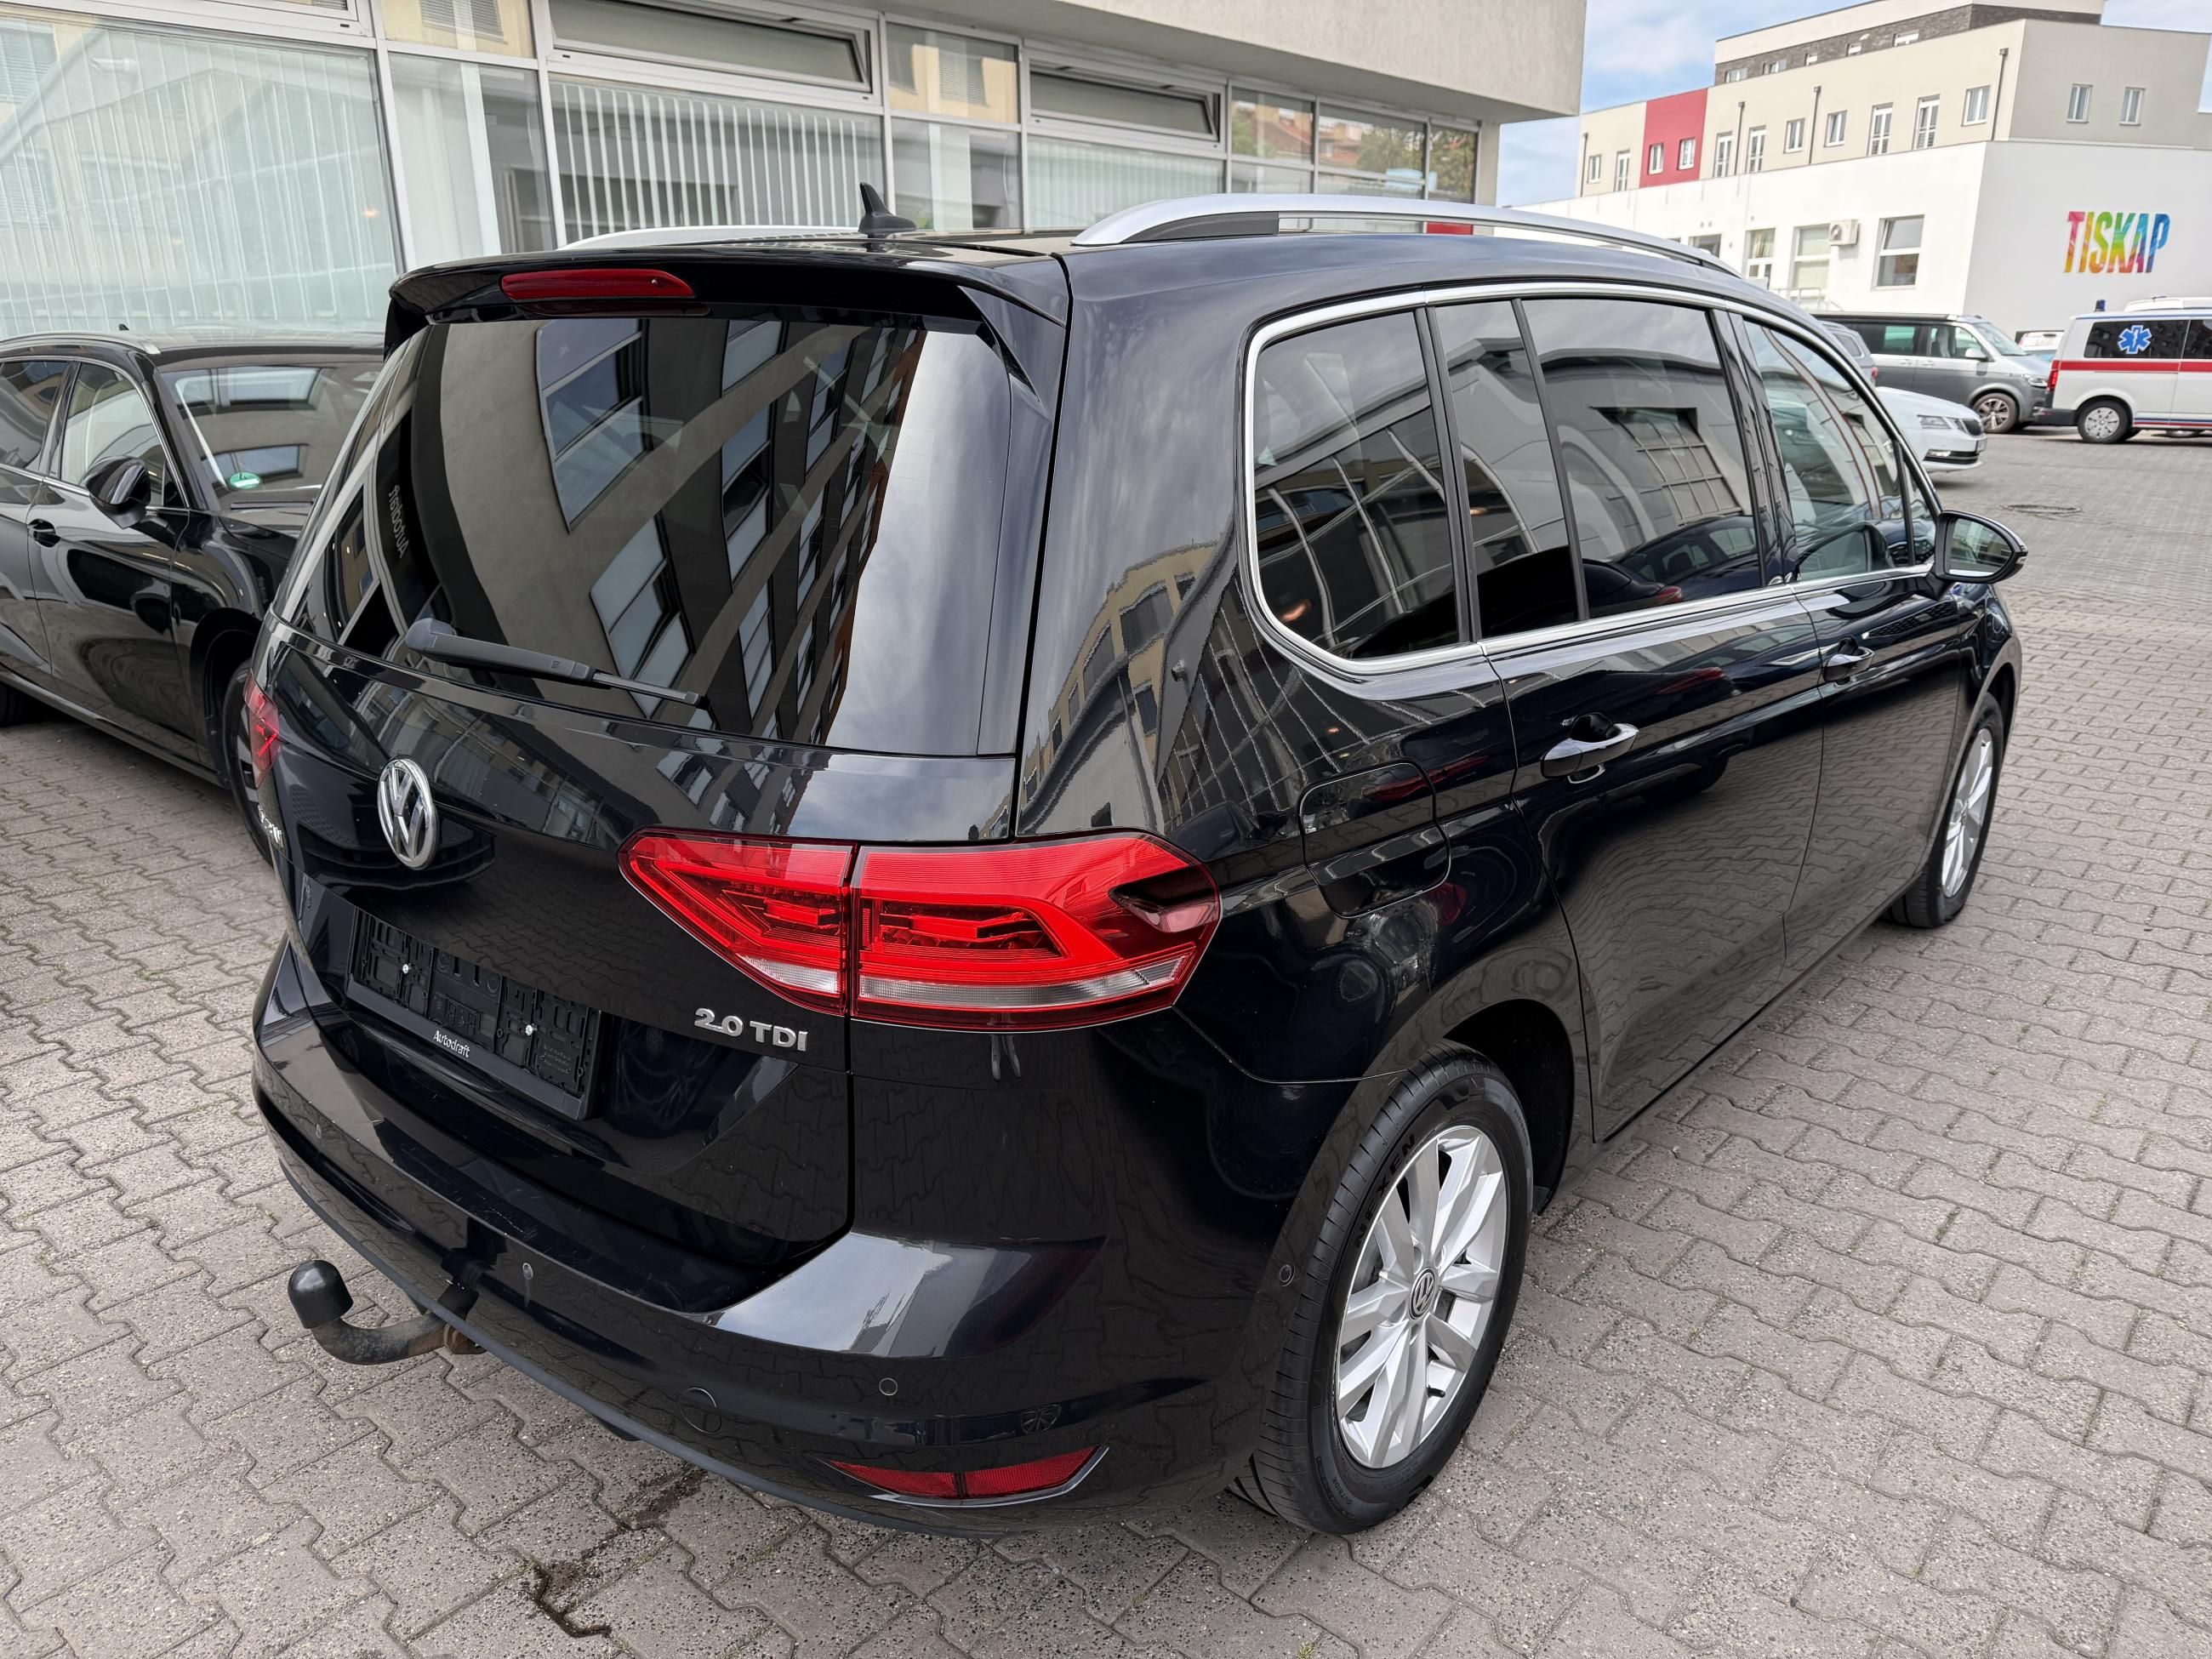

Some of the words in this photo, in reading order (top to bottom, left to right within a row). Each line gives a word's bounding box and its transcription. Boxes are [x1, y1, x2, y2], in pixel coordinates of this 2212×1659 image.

[2064, 210, 2171, 274] TISKAP
[433, 1029, 470, 1058] Autodraft
[693, 1007, 744, 1038] 2.0
[749, 1020, 809, 1052] TDI
[1354, 1134, 1416, 1248] NEXEN
